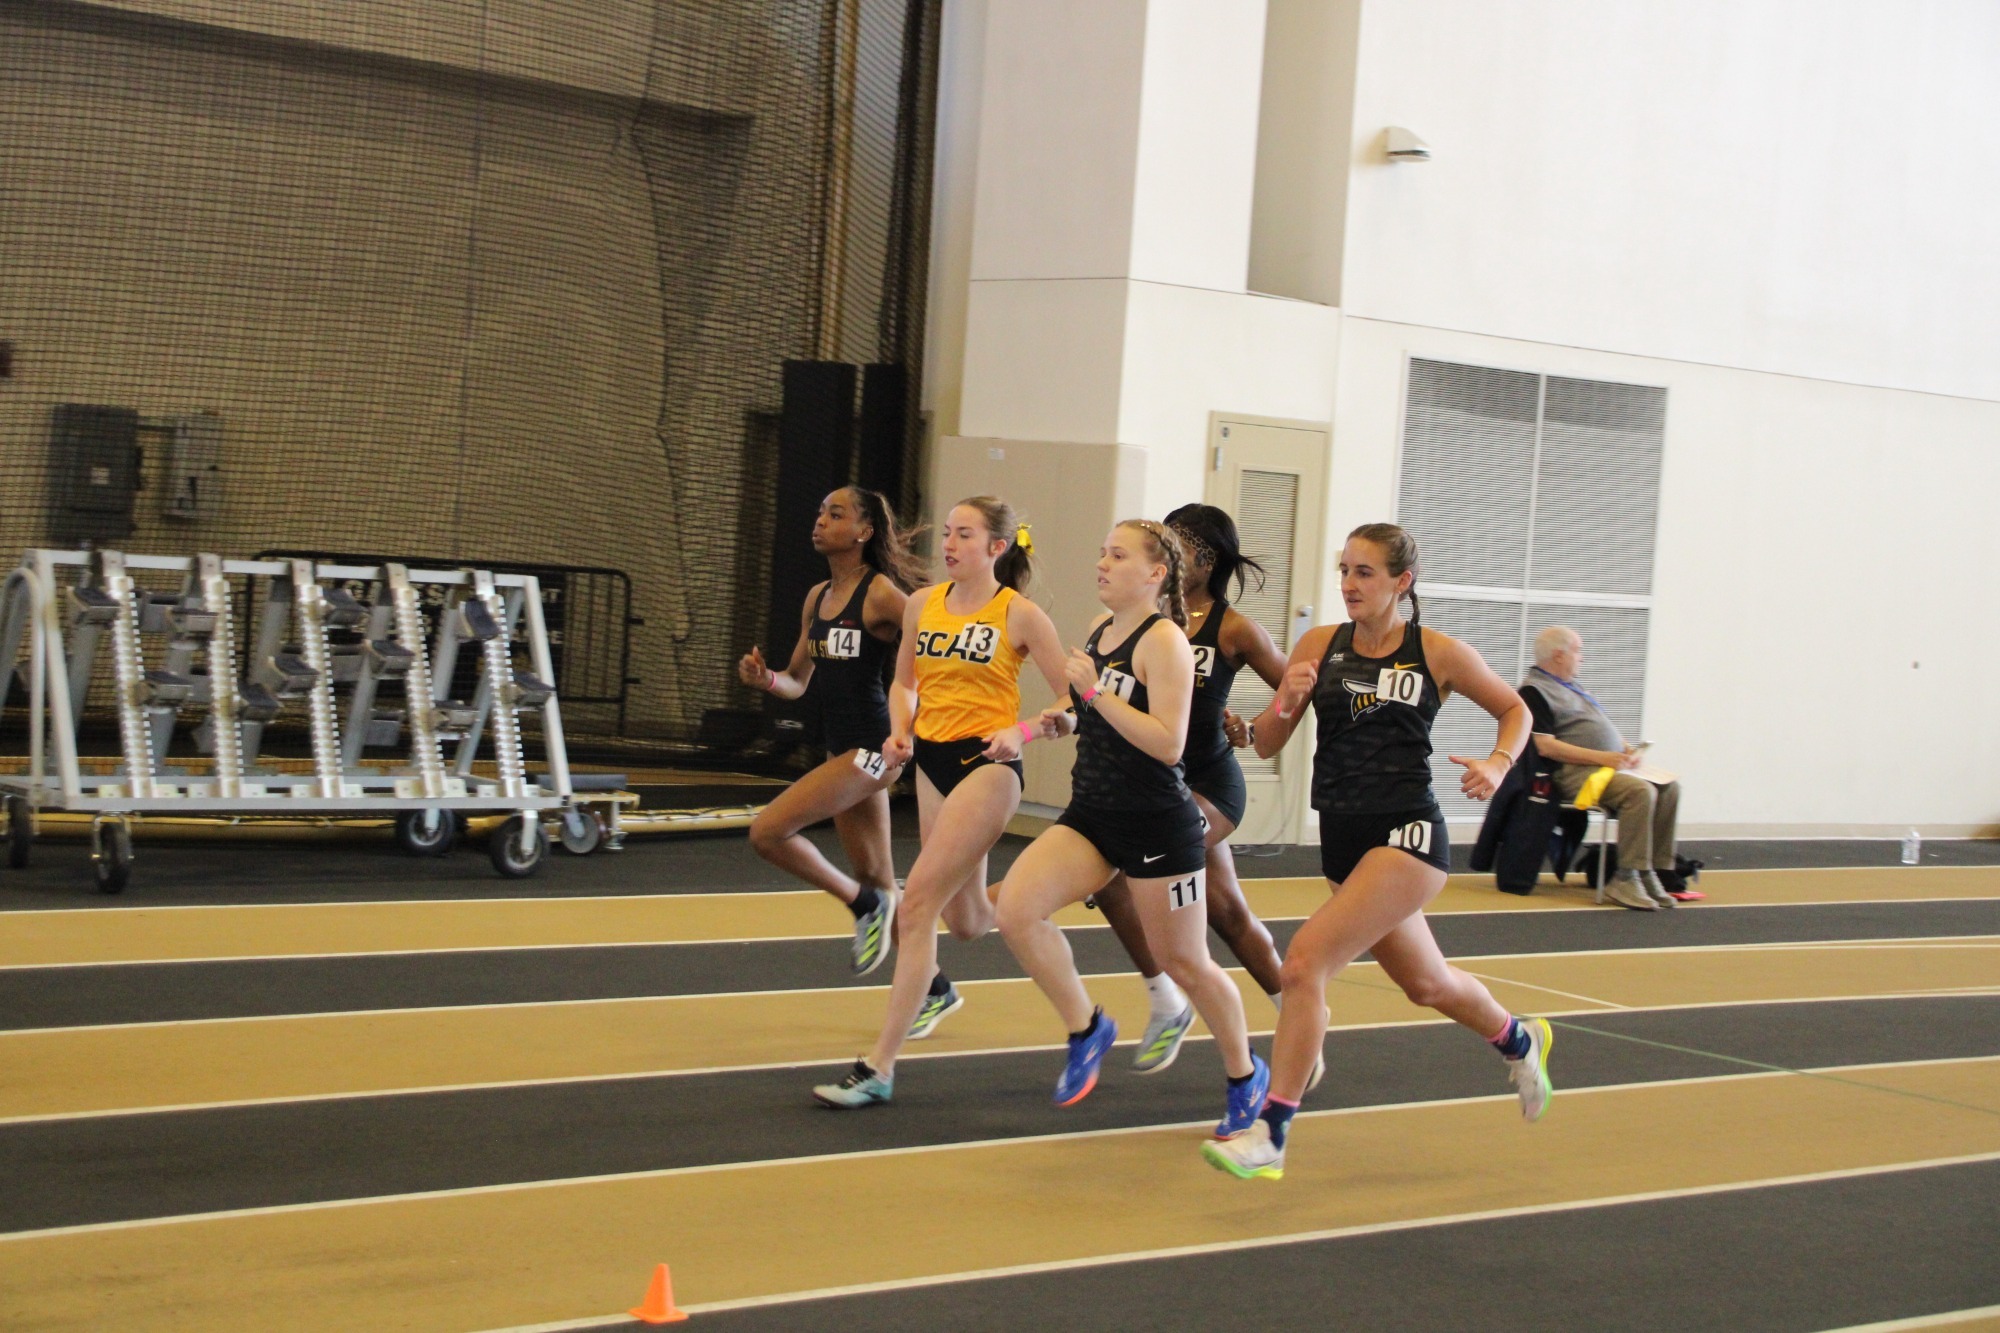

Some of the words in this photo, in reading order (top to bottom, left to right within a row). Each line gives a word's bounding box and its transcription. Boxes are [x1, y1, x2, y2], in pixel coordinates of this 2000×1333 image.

[833, 628, 855, 655] 14
[964, 625, 994, 652] 13
[1104, 670, 1125, 696] 11
[1387, 671, 1415, 701] 10
[863, 750, 883, 775] 14
[1397, 822, 1424, 850] 10
[1171, 877, 1197, 907] 11
